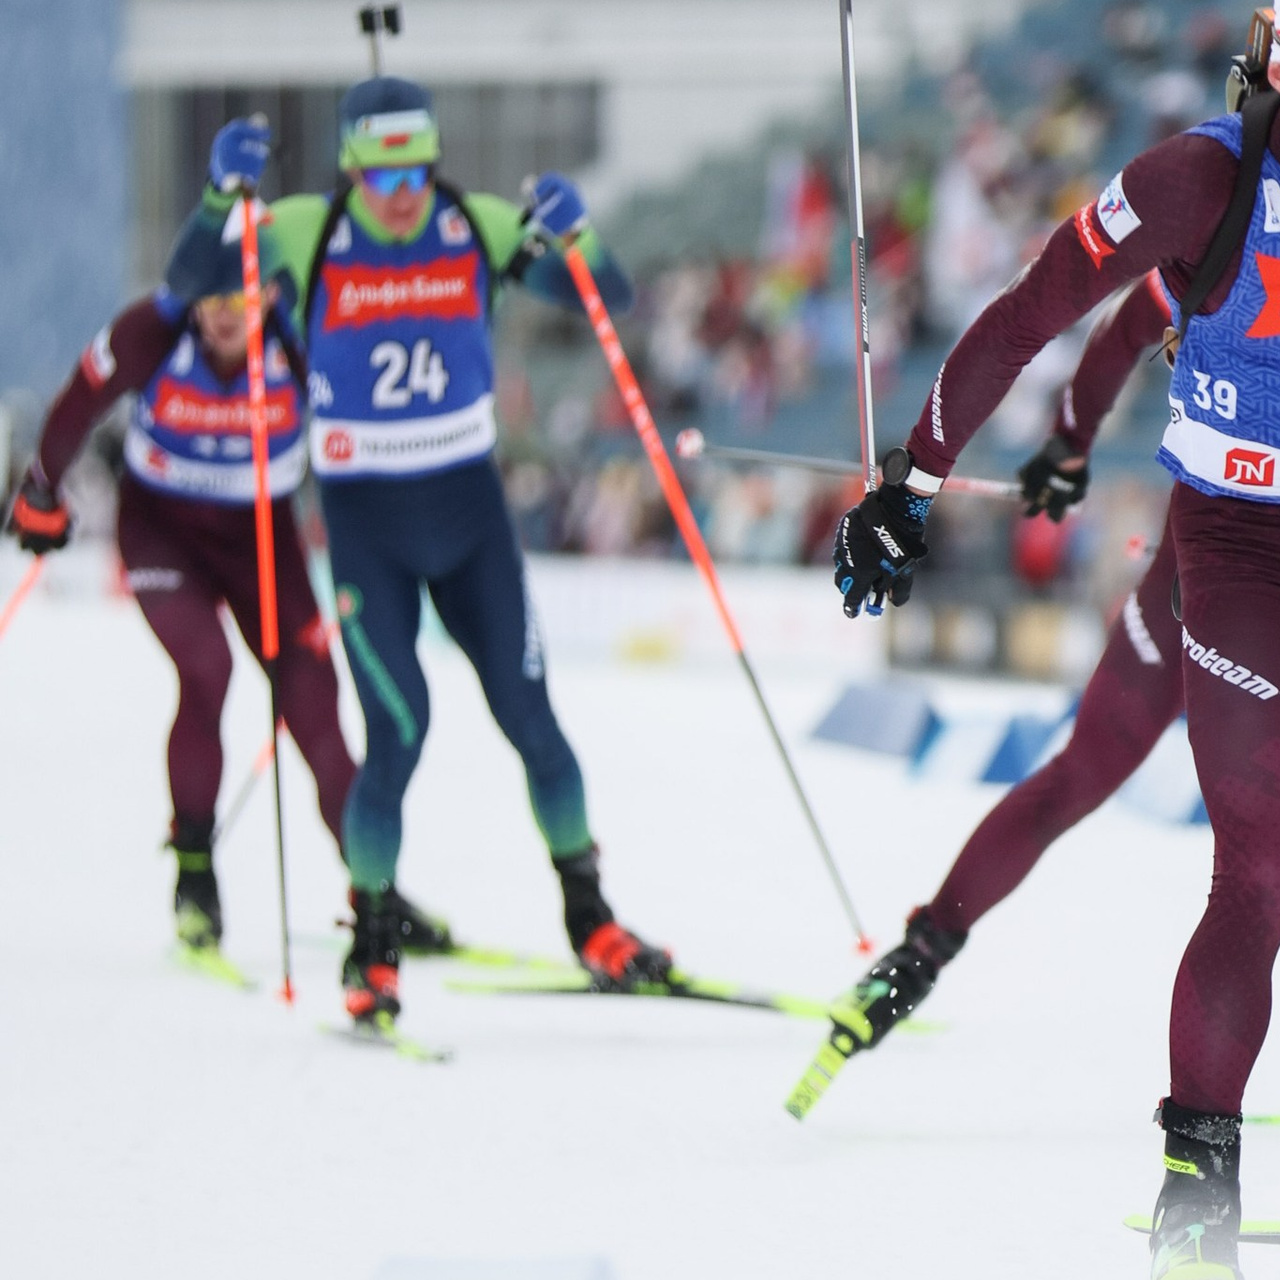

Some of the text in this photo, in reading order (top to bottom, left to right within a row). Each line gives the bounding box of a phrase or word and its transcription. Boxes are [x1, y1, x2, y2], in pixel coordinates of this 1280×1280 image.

[369, 338, 448, 409] 24
[1192, 369, 1237, 420] 39
[873, 525, 905, 558] SWIX
